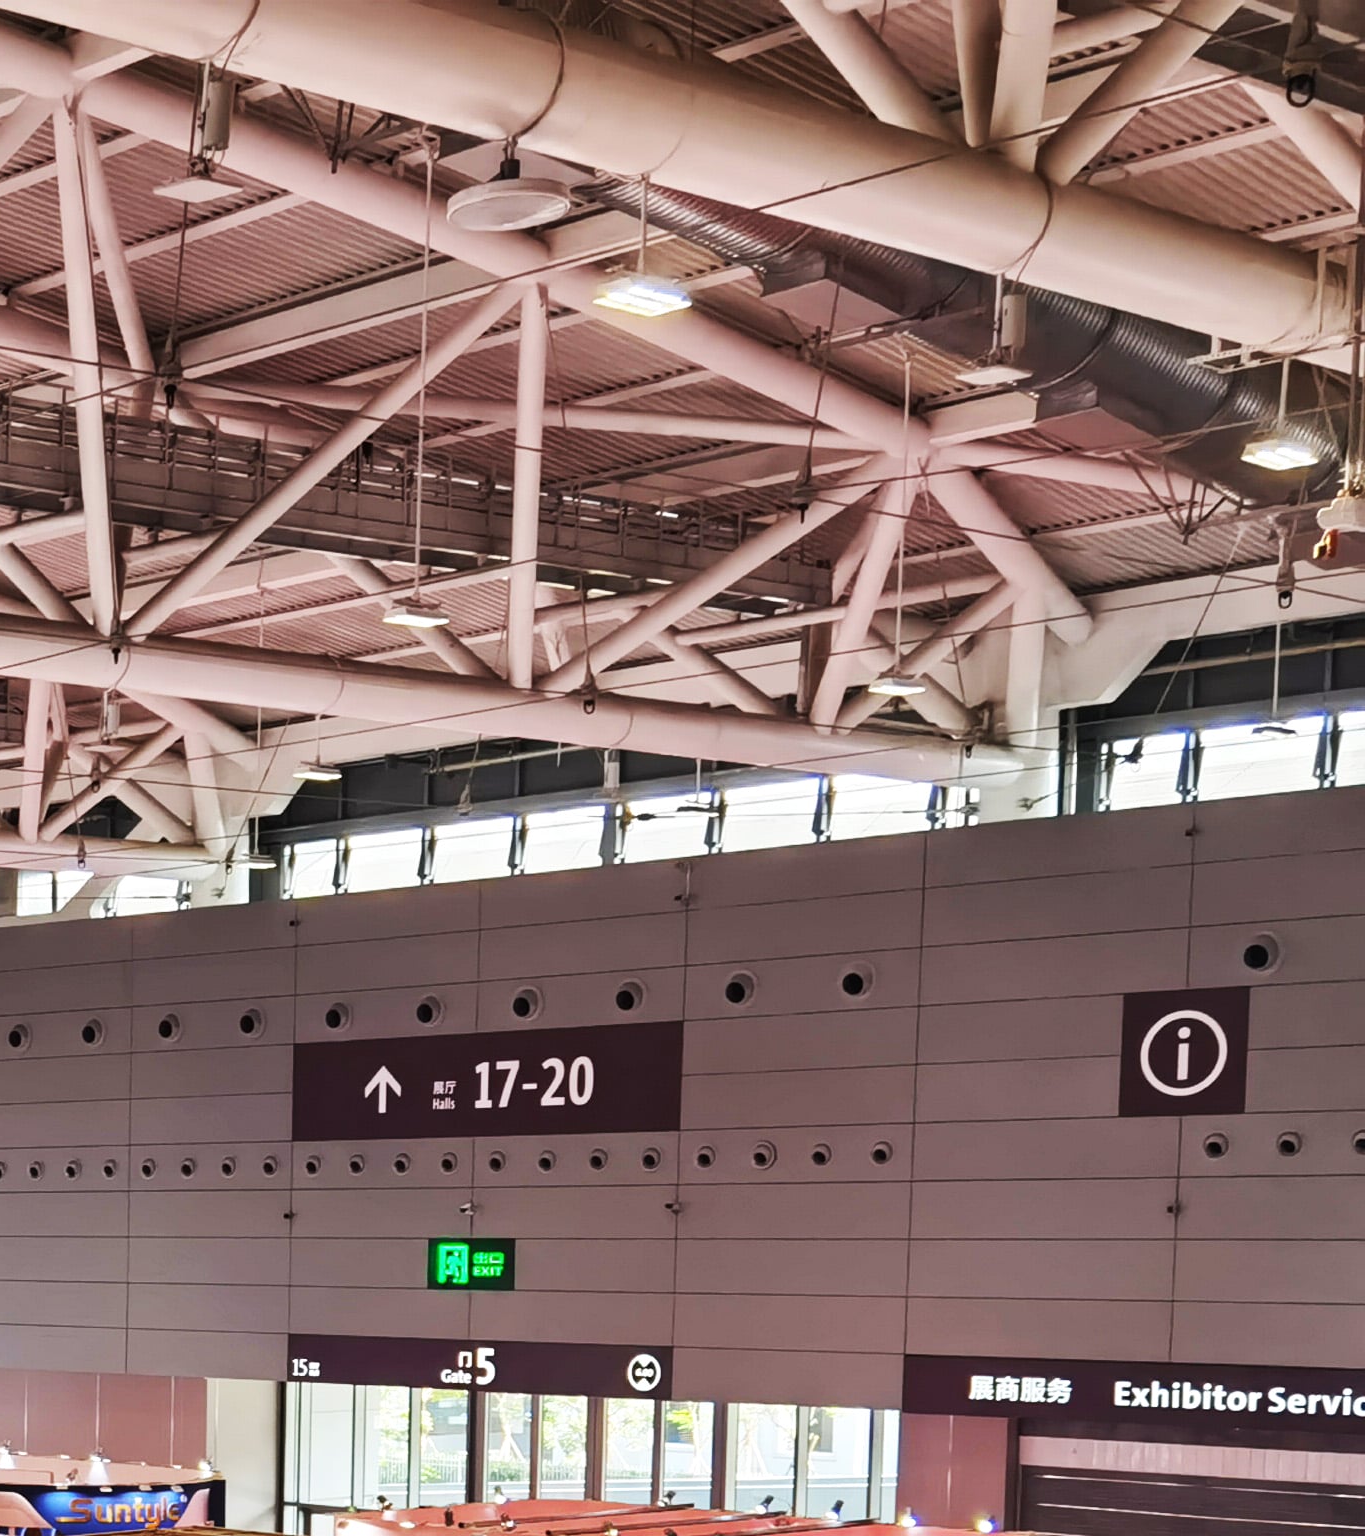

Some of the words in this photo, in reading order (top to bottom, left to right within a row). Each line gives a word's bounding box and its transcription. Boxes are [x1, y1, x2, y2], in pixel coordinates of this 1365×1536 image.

[433, 1080, 457, 1096] 展厅
[475, 1056, 595, 1110] 17-20
[432, 1097, 456, 1111] Halls
[473, 1252, 504, 1265] 出口
[473, 1265, 504, 1278] EXIT
[292, 1358, 309, 1377] 15
[476, 1348, 496, 1385] 5
[441, 1368, 472, 1385] Gate
[969, 1375, 1073, 1406] 展商服务
[1113, 1380, 1259, 1413] Exhibitor
[57, 1496, 181, 1530] Suntyle
